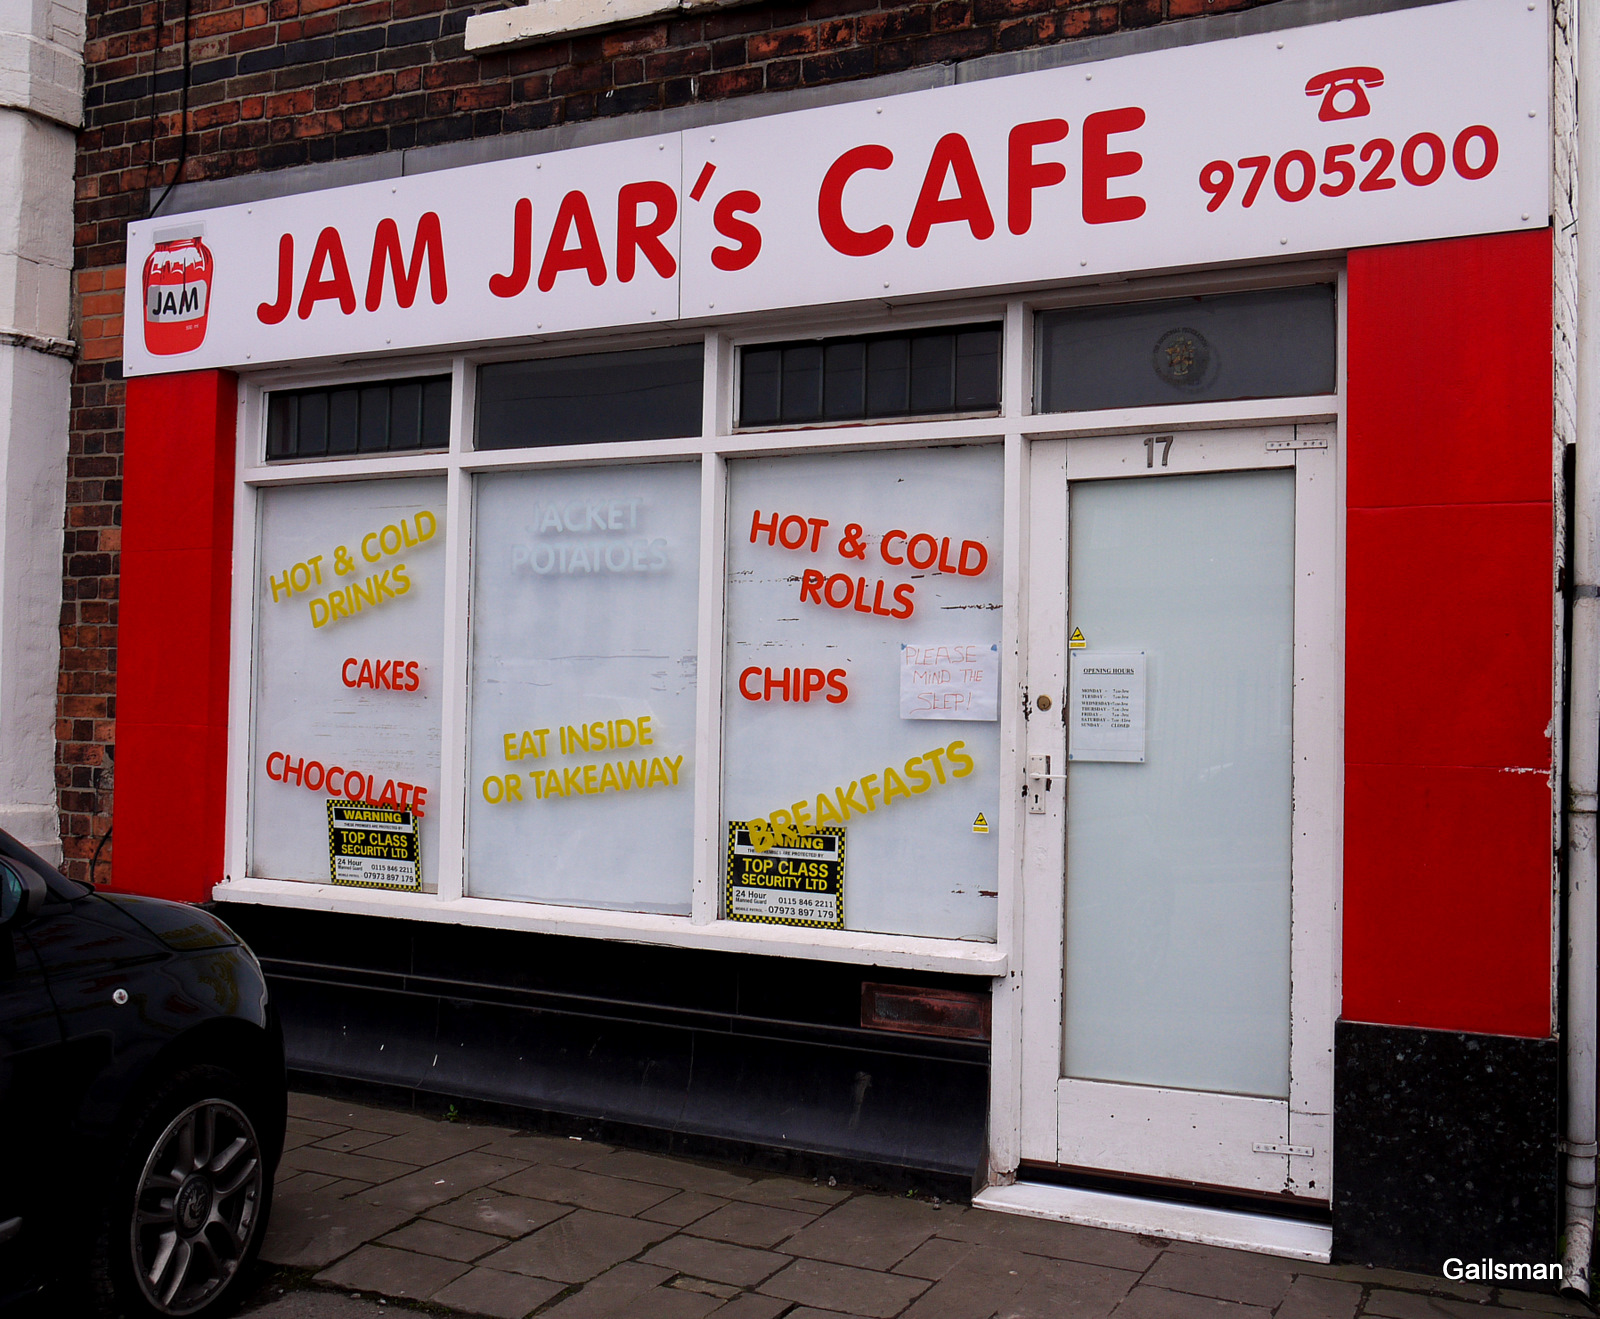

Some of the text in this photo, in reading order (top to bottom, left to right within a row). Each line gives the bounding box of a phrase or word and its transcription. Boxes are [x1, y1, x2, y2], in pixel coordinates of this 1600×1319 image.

[1199, 124, 1499, 213] 9705200
[257, 106, 1146, 325] JAM JAR's CAFE
[152, 287, 198, 315] JAM
[1144, 436, 1173, 468] 17
[525, 497, 643, 532] JACKET
[270, 510, 437, 603] HOT & COLD
[511, 538, 668, 575] POTATOES
[749, 510, 988, 577] HOT & COLD
[309, 564, 411, 628] DRINKS
[799, 568, 915, 619] ROLLS
[905, 646, 977, 665] PLEASE
[1083, 667, 1135, 675] OPENING HOURS
[341, 657, 420, 692] CAKES
[739, 666, 849, 703] CHIPS
[960, 668, 984, 683] THE
[503, 715, 653, 761] EAT INSIDE
[266, 751, 428, 817] CHOCOLATE
[482, 754, 683, 804] OR TAKEAWAY
[747, 740, 975, 853] BREAKFASTS
[343, 810, 402, 823] WARNING
[341, 831, 408, 847] TOP CLASS
[341, 844, 408, 858] SECURITY LTD
[363, 871, 385, 880] 07973
[386, 873, 399, 881] 897
[401, 875, 414, 883] 179
[741, 873, 828, 891] SECURITY LTD
[742, 857, 829, 878] TOP CLASS
[748, 891, 767, 899] Hour
[778, 897, 833, 908] 0115 846 2211
[768, 906, 834, 918] 07973 897 179
